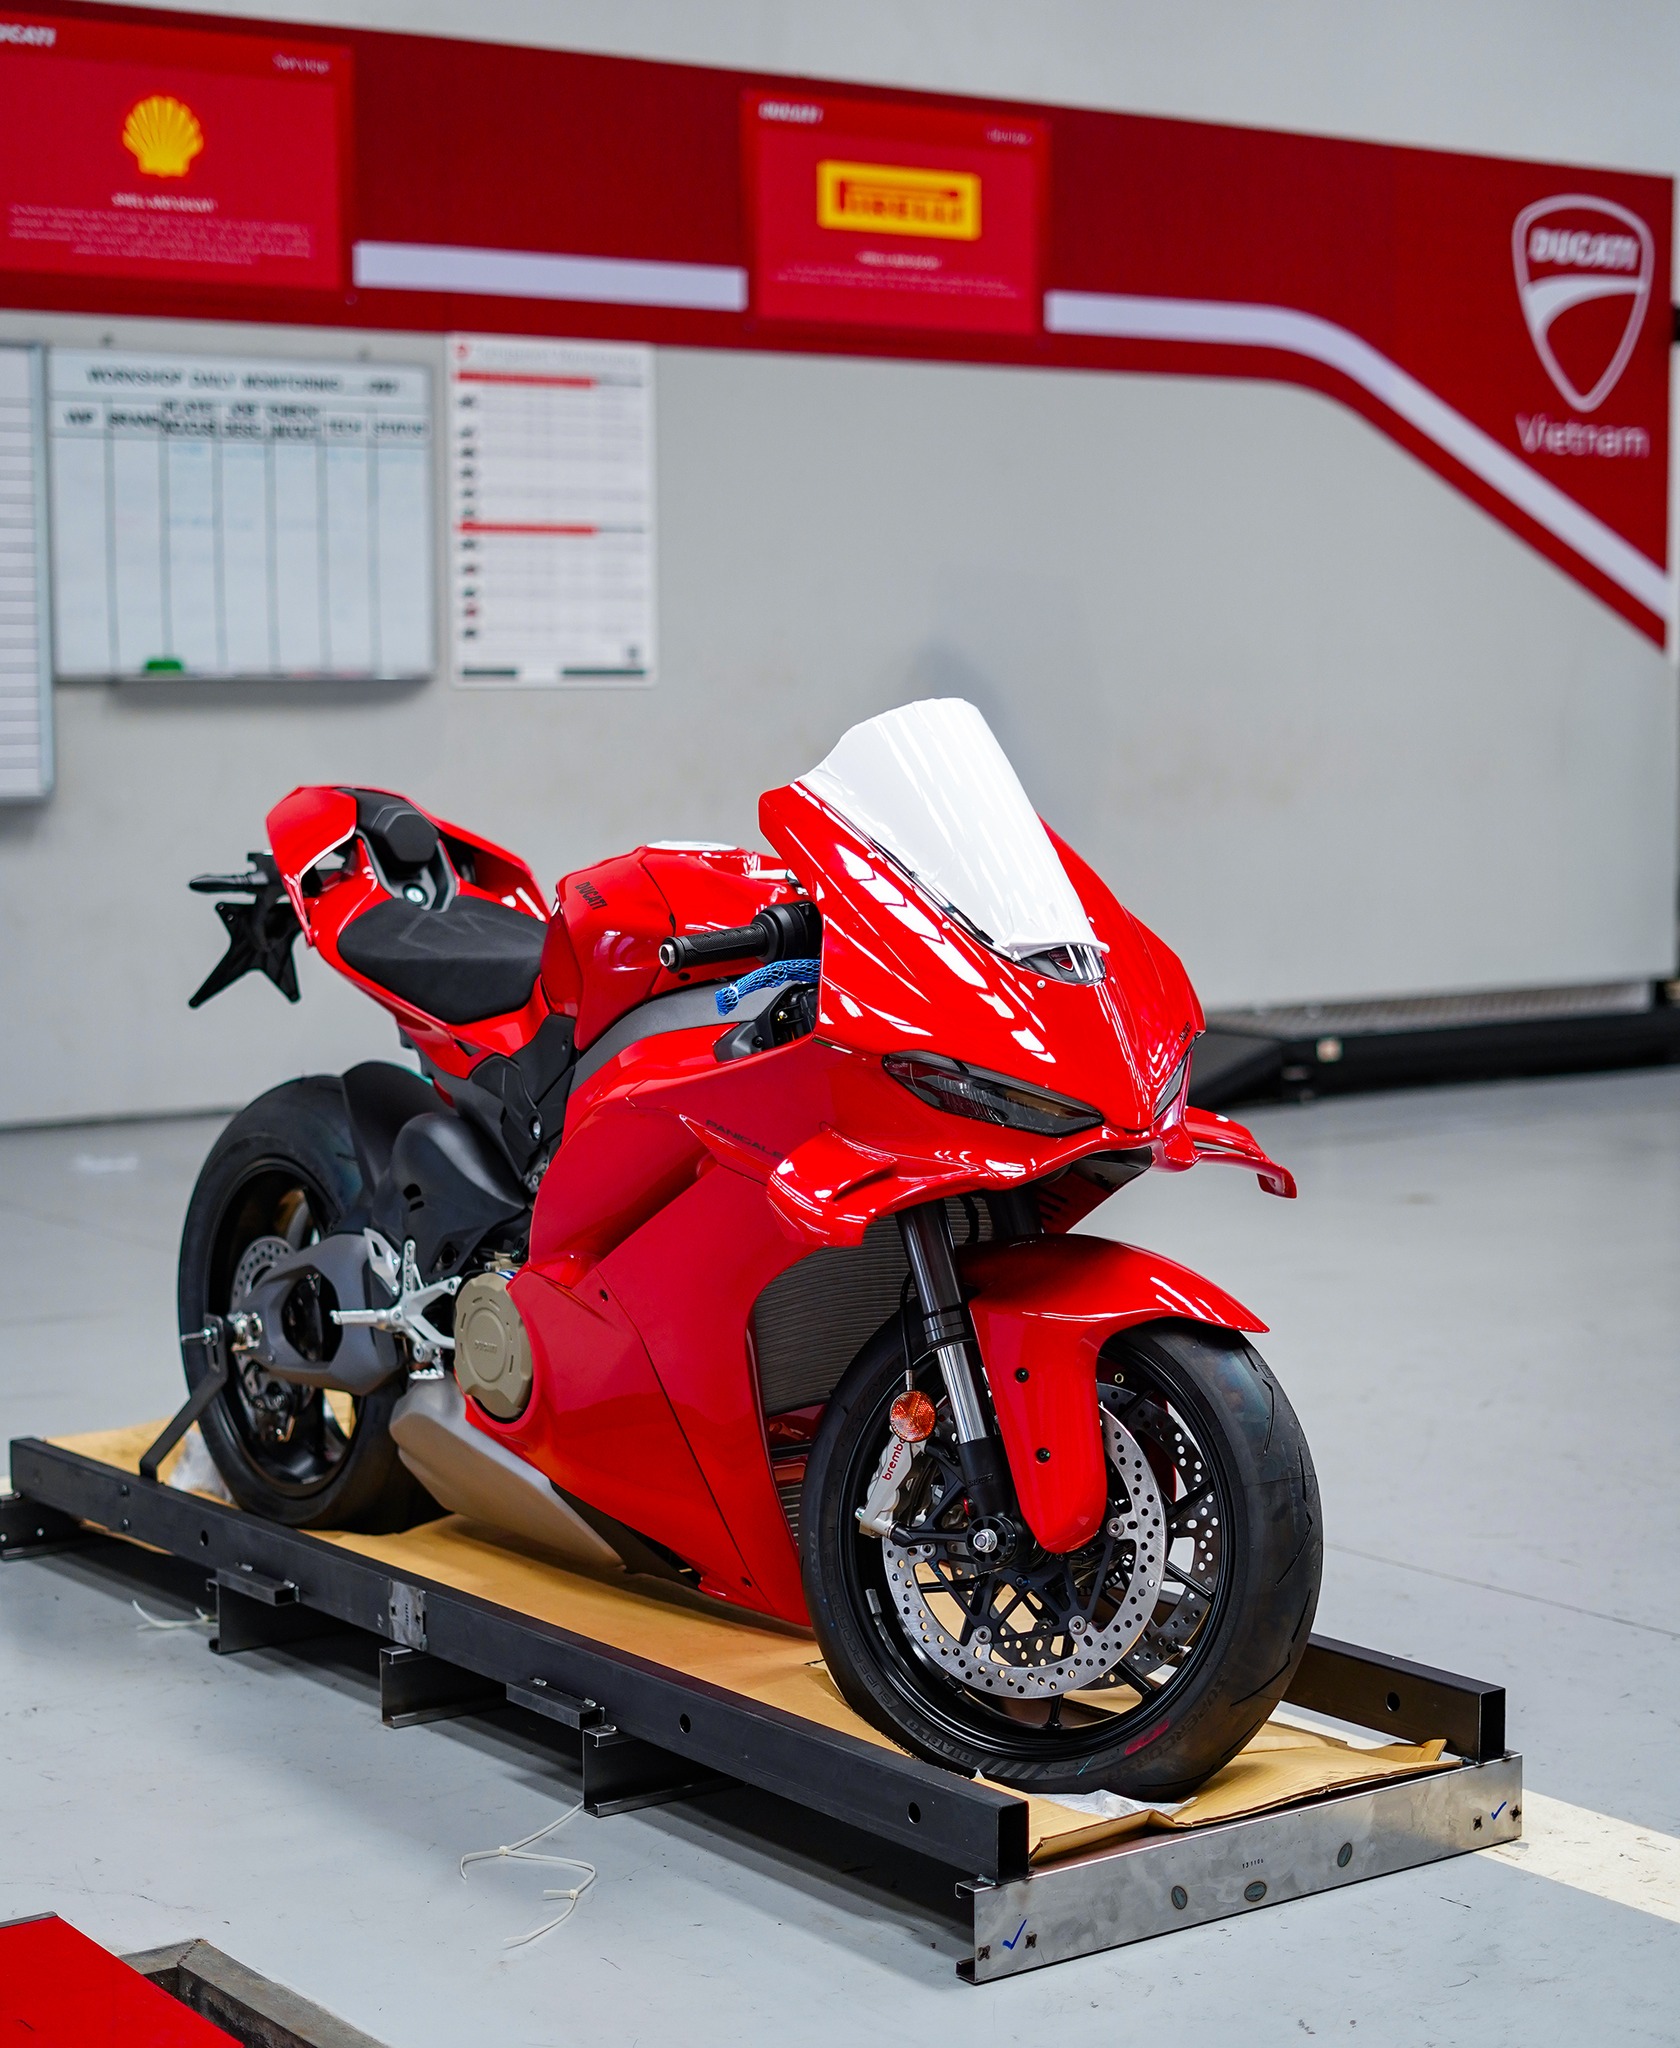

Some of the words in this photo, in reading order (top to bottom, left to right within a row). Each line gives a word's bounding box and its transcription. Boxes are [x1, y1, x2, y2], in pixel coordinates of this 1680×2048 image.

[1529, 227, 1638, 271] DUCATI
[1516, 415, 1649, 457] Vietnam
[575, 881, 608, 911] DUCATI
[904, 1716, 974, 1765] DIABLO
